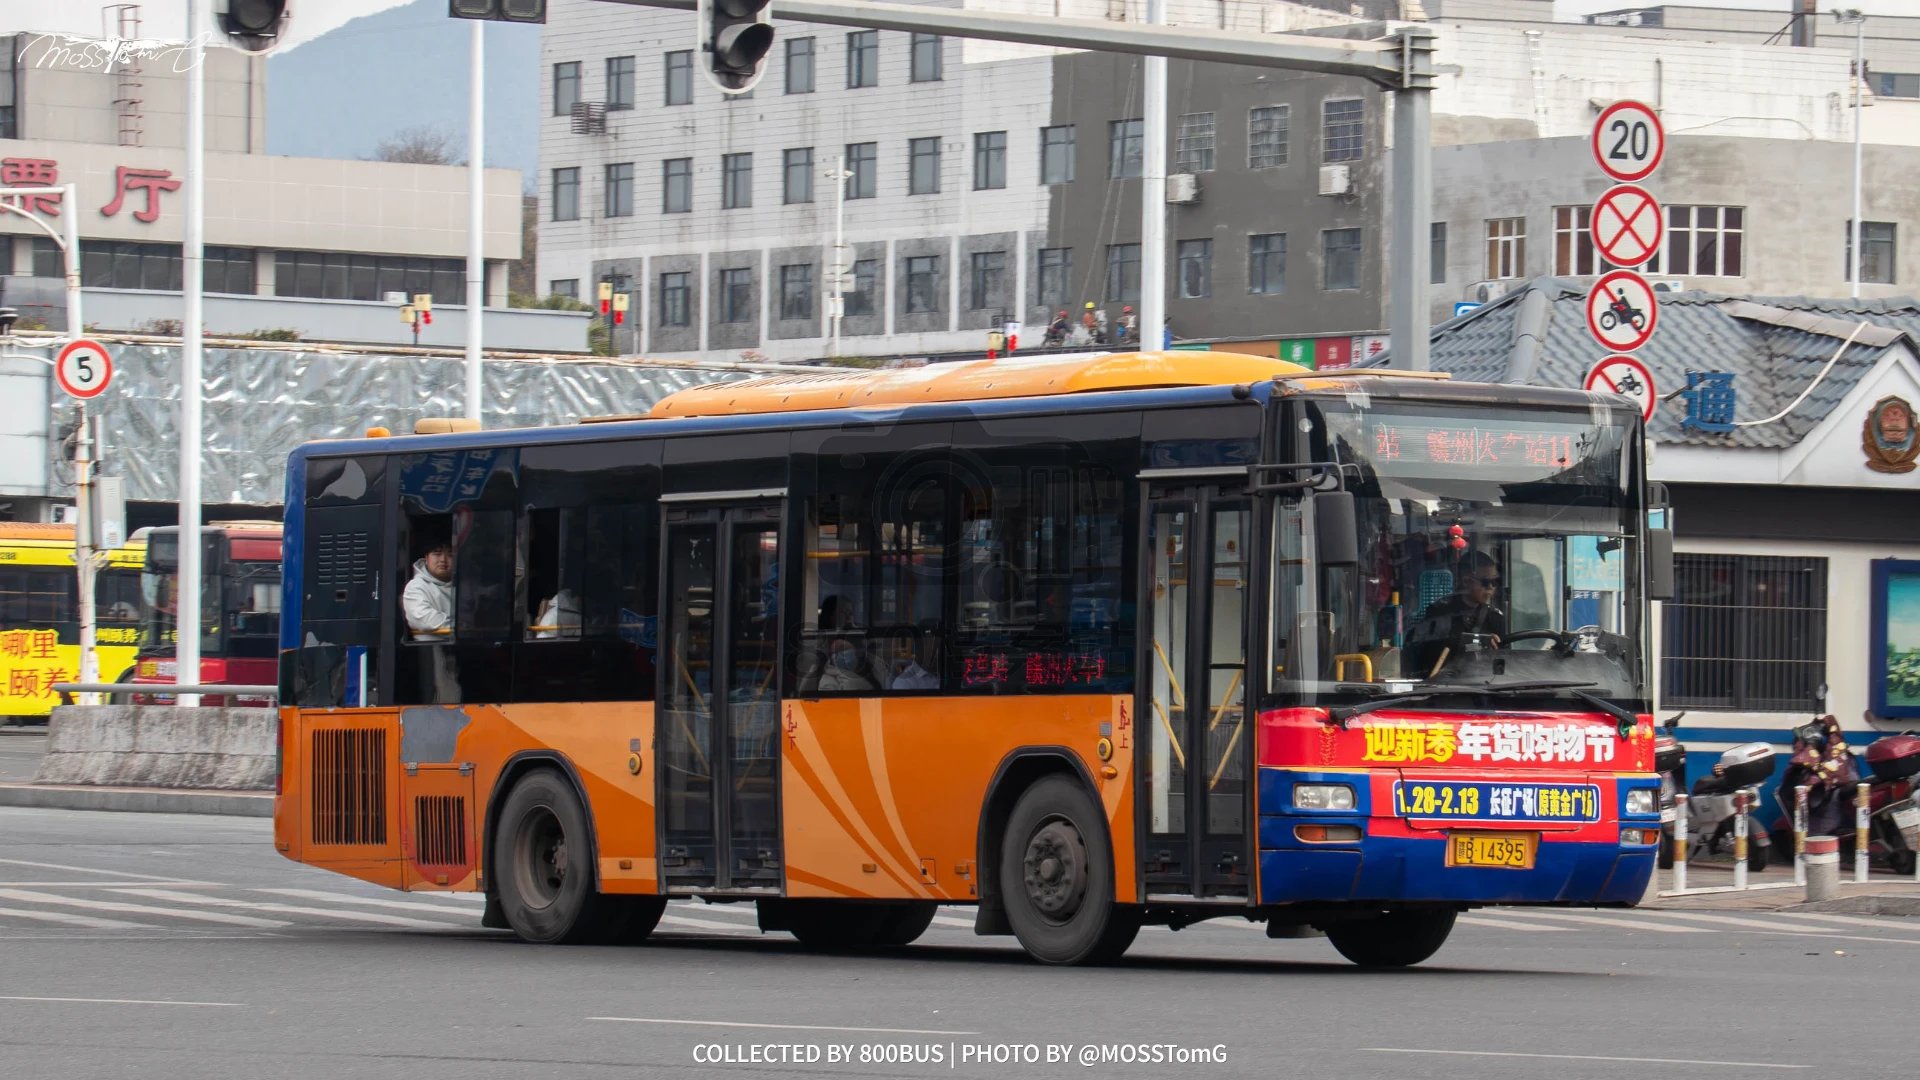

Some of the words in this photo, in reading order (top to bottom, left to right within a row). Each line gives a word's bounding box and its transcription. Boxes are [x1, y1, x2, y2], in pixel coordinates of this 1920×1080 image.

[1609, 119, 1649, 161] 20
[76, 355, 94, 384] 5
[1376, 427, 1400, 459] 站
[1, 632, 58, 659] 哪里
[787, 735, 797, 750] 下
[1119, 734, 1129, 749] 上
[1396, 786, 1479, 815] 1.28-2.13
